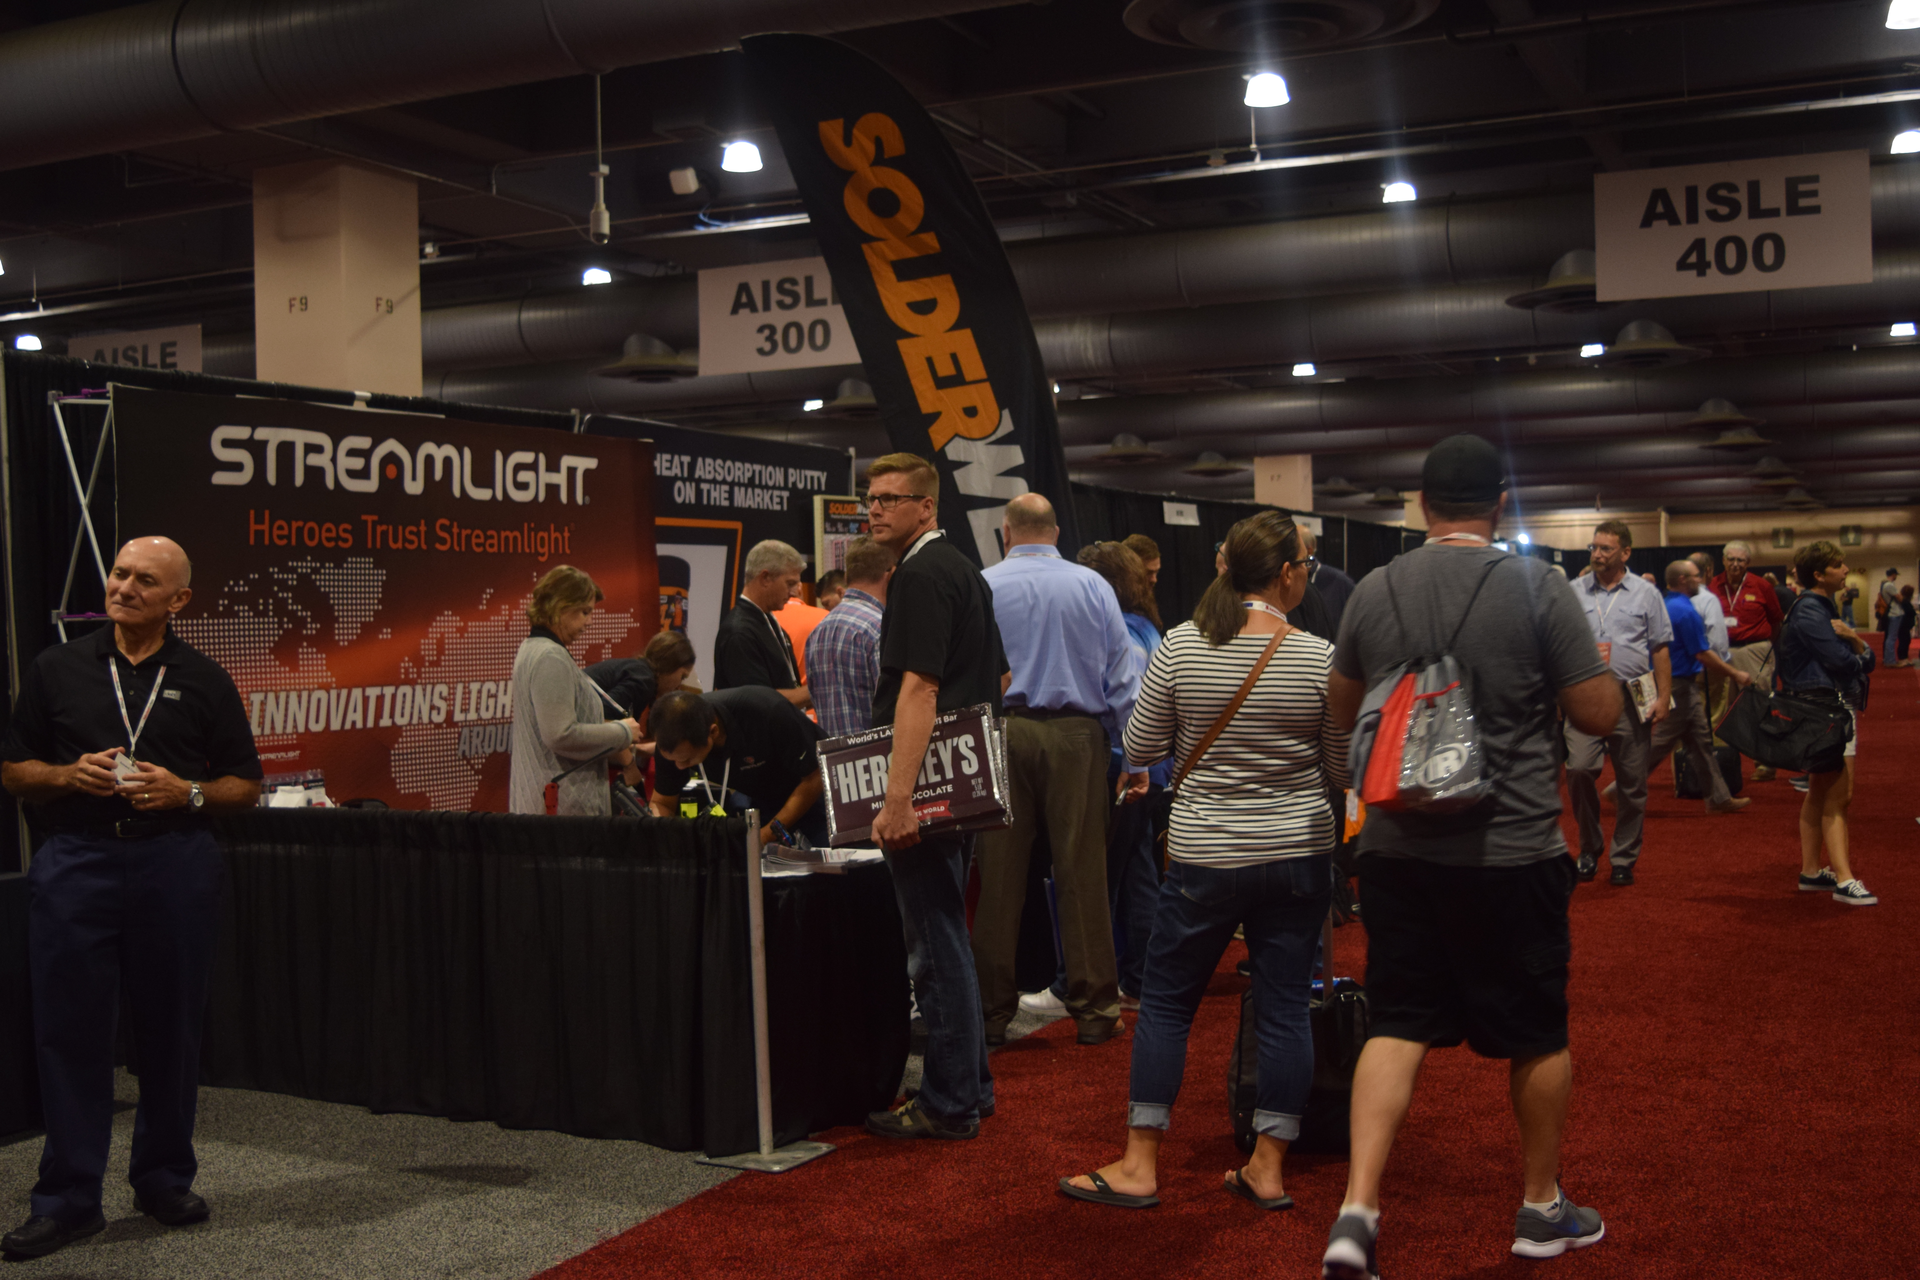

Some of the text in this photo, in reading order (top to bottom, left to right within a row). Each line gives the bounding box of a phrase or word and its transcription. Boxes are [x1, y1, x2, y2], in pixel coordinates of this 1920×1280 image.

[1639, 174, 1822, 229] AISLE
[1676, 232, 1786, 278] 400
[94, 341, 178, 370] AISLE
[756, 318, 832, 358] 300
[210, 424, 599, 506] STREAMLIGHT
[694, 457, 784, 488] ABSORPTION
[788, 467, 827, 492] PUTTY
[673, 480, 790, 511] ON THE MARKET
[248, 509, 571, 562] Heroes Trust Streamlight
[250, 680, 513, 736] INNOVATIONS LIGH
[847, 730, 879, 746] World's
[943, 713, 958, 724] Bar
[836, 733, 980, 805] HEREY'S
[871, 800, 885, 811] MI
[922, 805, 946, 815] WORLD
